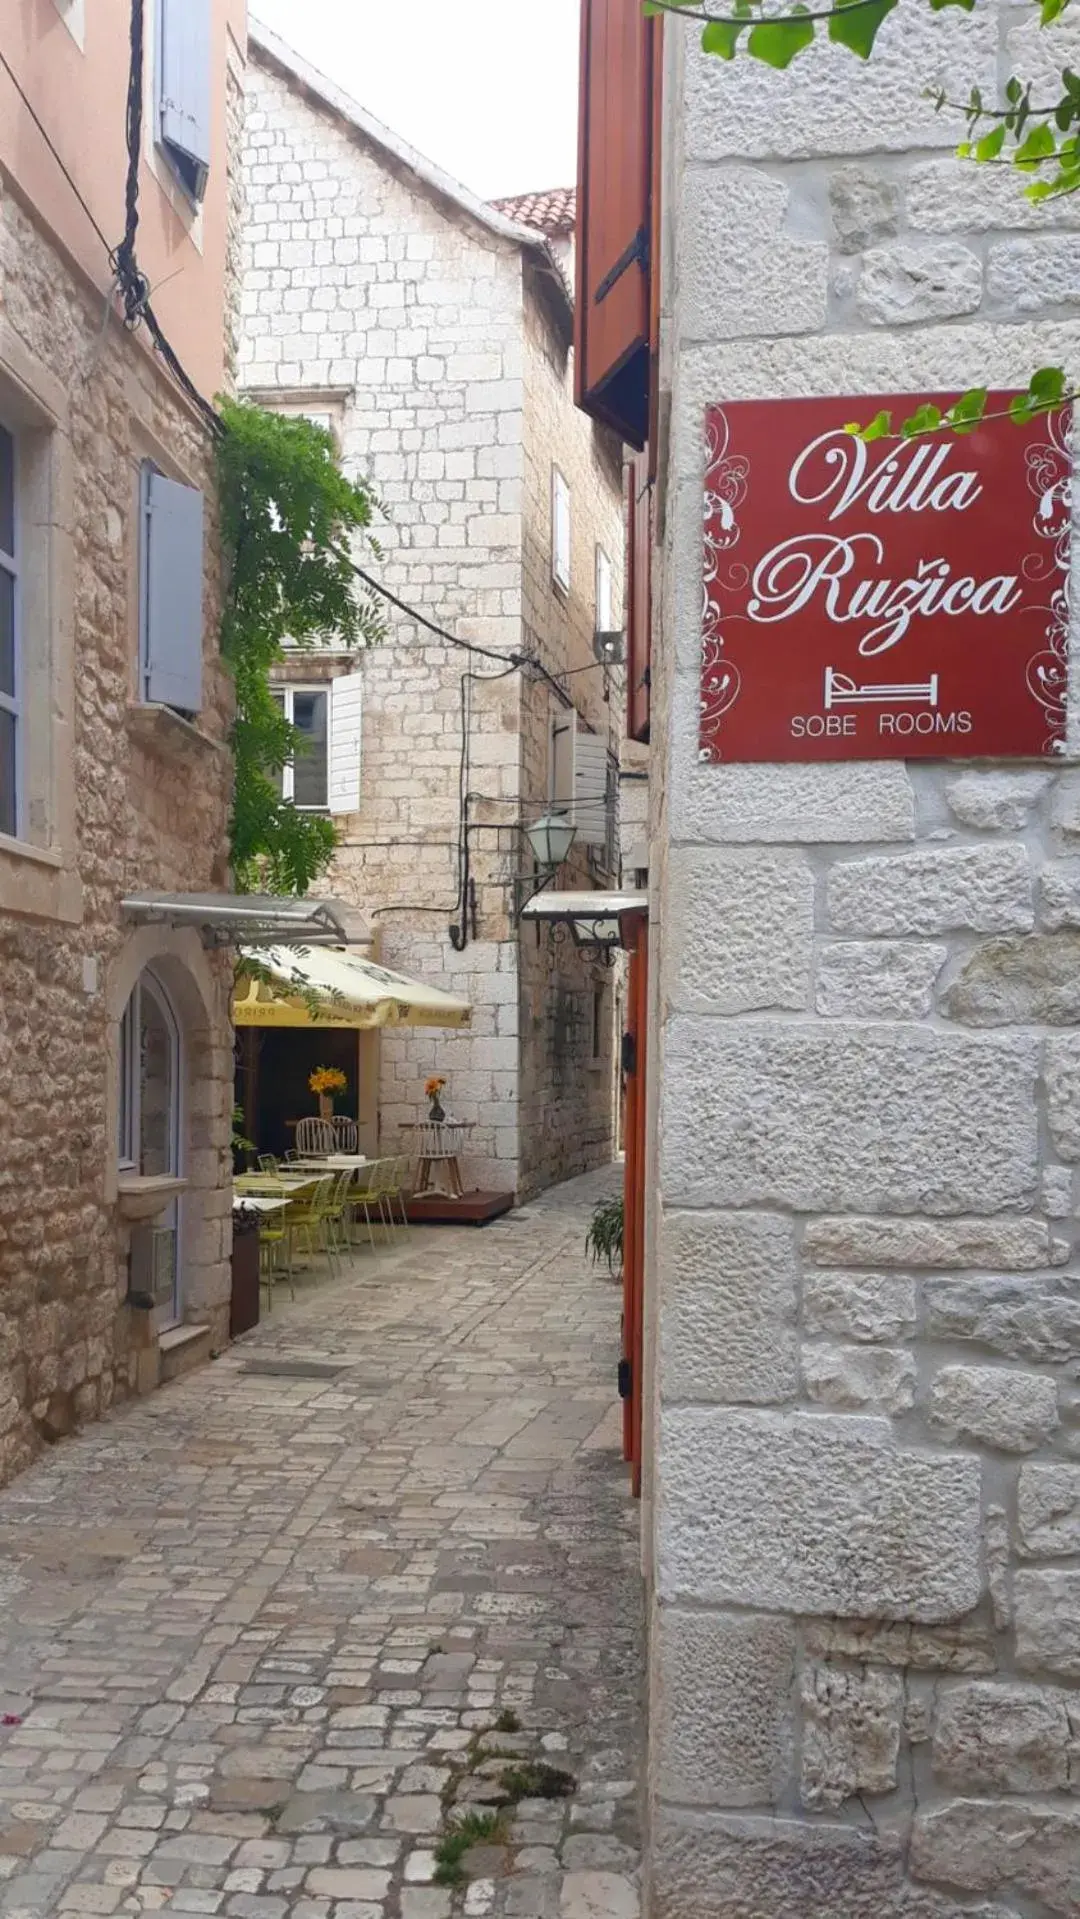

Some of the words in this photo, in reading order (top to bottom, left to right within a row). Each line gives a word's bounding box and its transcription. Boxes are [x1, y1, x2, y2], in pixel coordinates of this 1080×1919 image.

[789, 429, 983, 521] Villa
[747, 533, 1023, 656] Ružica
[790, 715, 857, 737] SOBE
[879, 711, 972, 735] ROOMS
